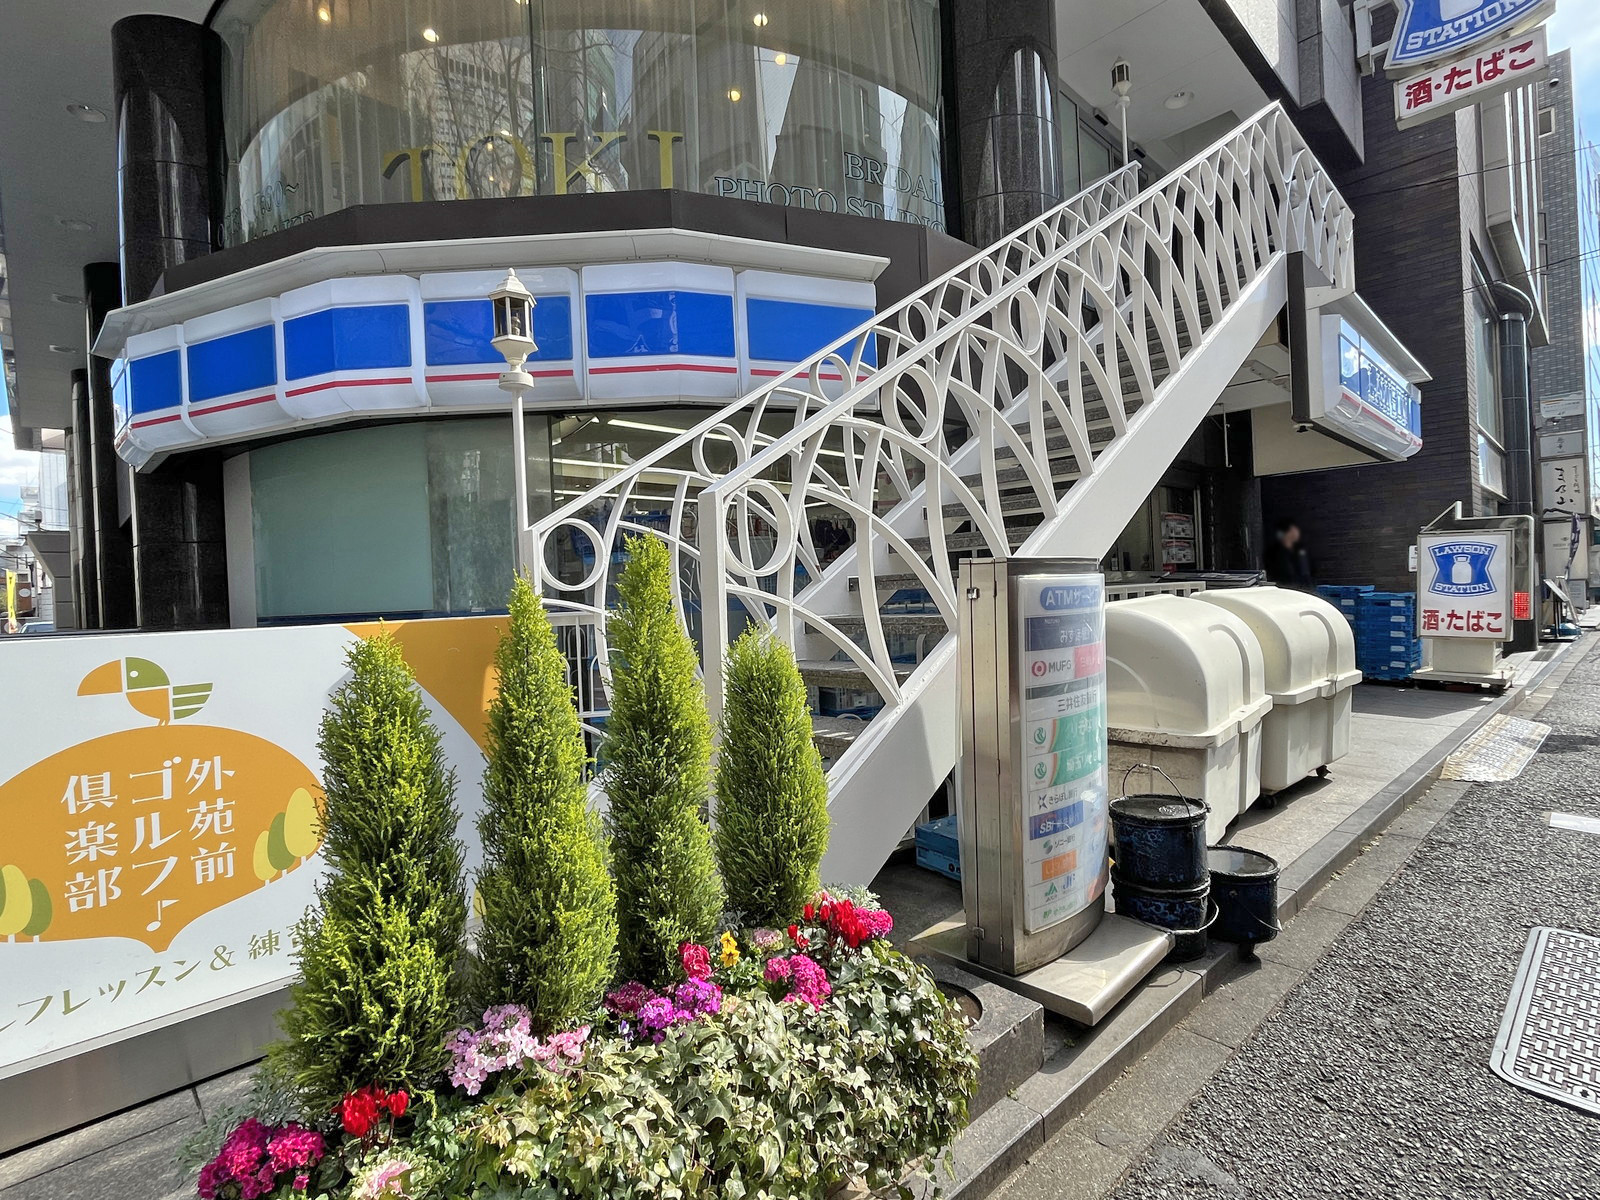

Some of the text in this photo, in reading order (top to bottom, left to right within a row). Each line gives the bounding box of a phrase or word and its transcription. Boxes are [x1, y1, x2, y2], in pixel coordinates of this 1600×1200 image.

[1405, 40, 1536, 110] 酒・たばこ
[383, 130, 684, 202] TOKI
[715, 176, 838, 213] PHOTO
[844, 151, 945, 208] BRIDAL
[1434, 545, 1491, 557] LAWSON
[1434, 582, 1490, 593] STATION
[1422, 609, 1503, 633] 酒・たばこ
[60, 771, 123, 913] 倶楽部
[129, 756, 183, 897] ゴルフ
[185, 755, 237, 886] 外苑前
[210, 944, 236, 971] &
